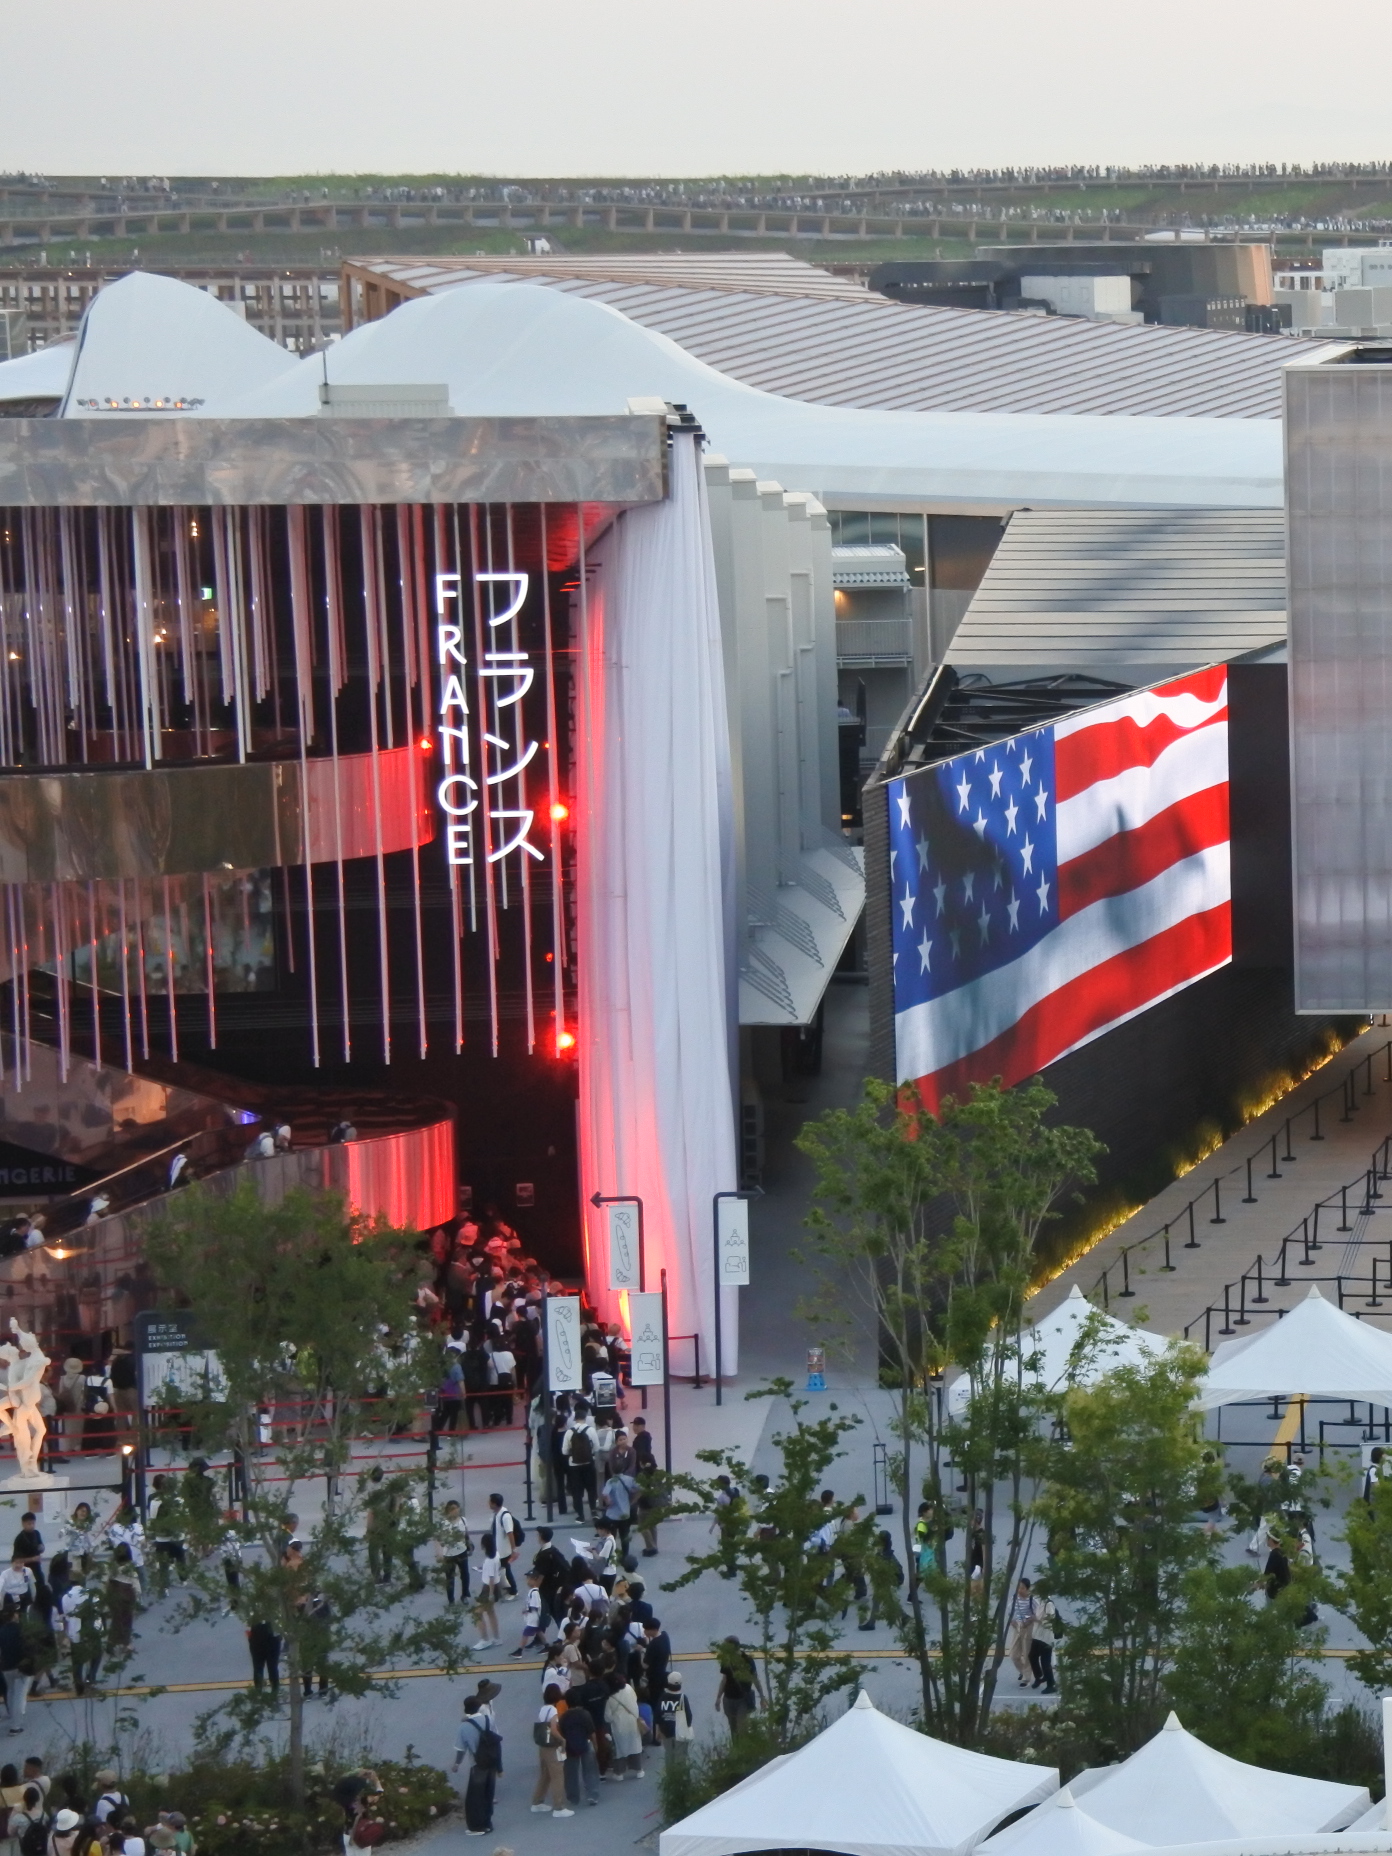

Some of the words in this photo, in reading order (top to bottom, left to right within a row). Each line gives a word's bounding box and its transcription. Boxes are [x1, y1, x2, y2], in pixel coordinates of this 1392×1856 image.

[436, 573, 479, 865] FRANCE
[475, 573, 545, 863] フランス
